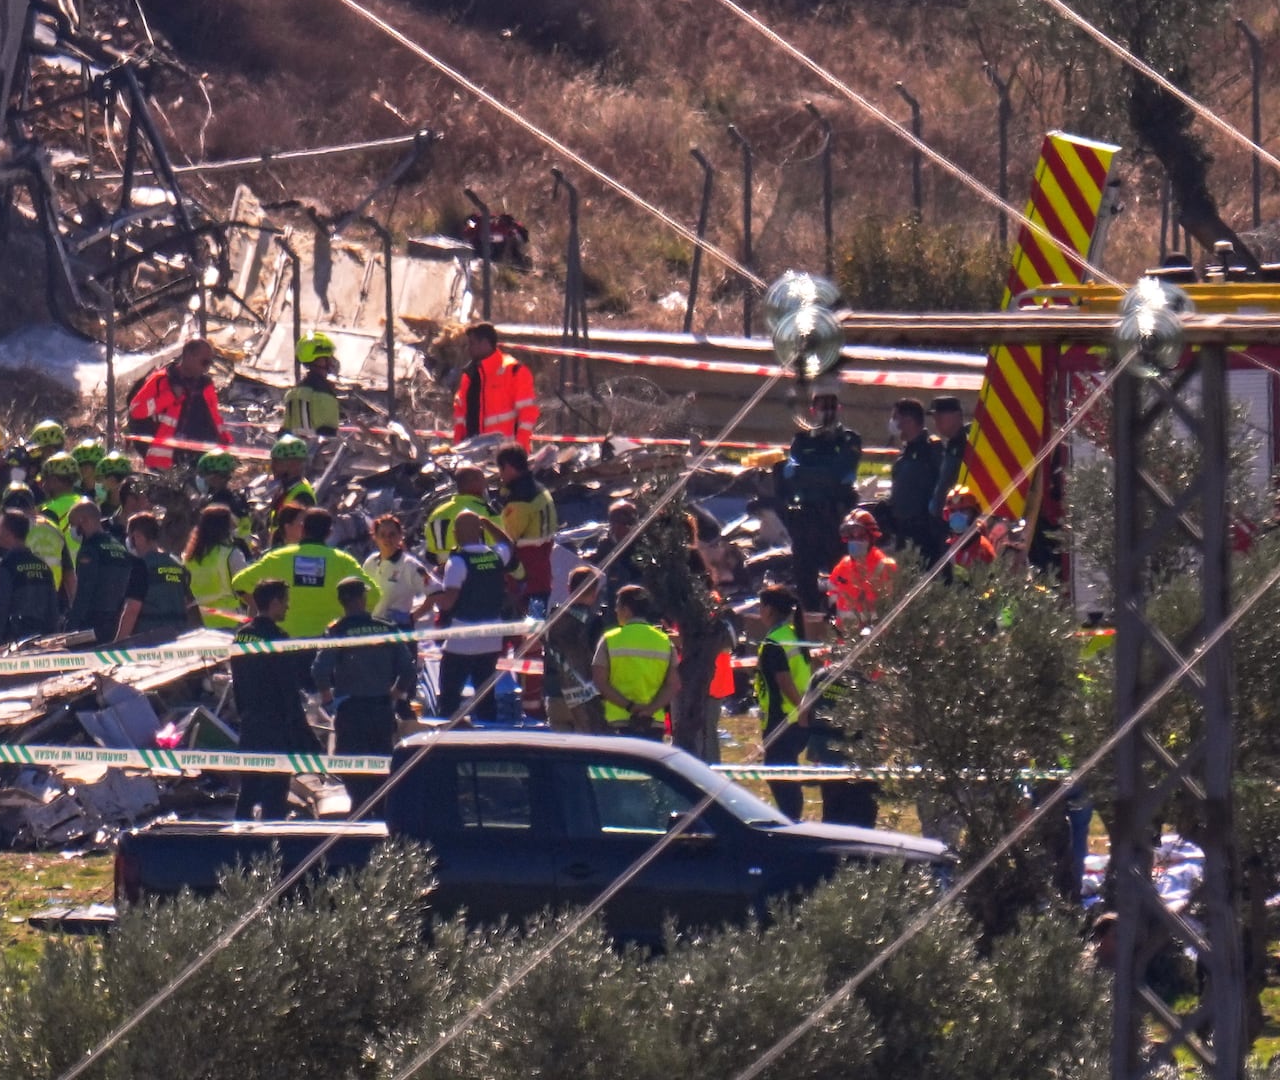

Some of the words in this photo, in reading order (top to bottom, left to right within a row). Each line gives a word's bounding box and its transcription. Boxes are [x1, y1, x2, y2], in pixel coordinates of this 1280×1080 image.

[34, 750, 60, 760] PASAR
[61, 751, 72, 760] NO
[75, 751, 93, 761] CIVIL
[96, 751, 128, 762] GUARDIA
[181, 754, 207, 765] PASAR
[209, 754, 219, 764] NO
[222, 755, 240, 765] CIVIL
[243, 756, 276, 767] GUARDIA
[328, 758, 352, 768] PASAR
[354, 759, 364, 768] NO
[367, 759, 385, 769] CIVIL
